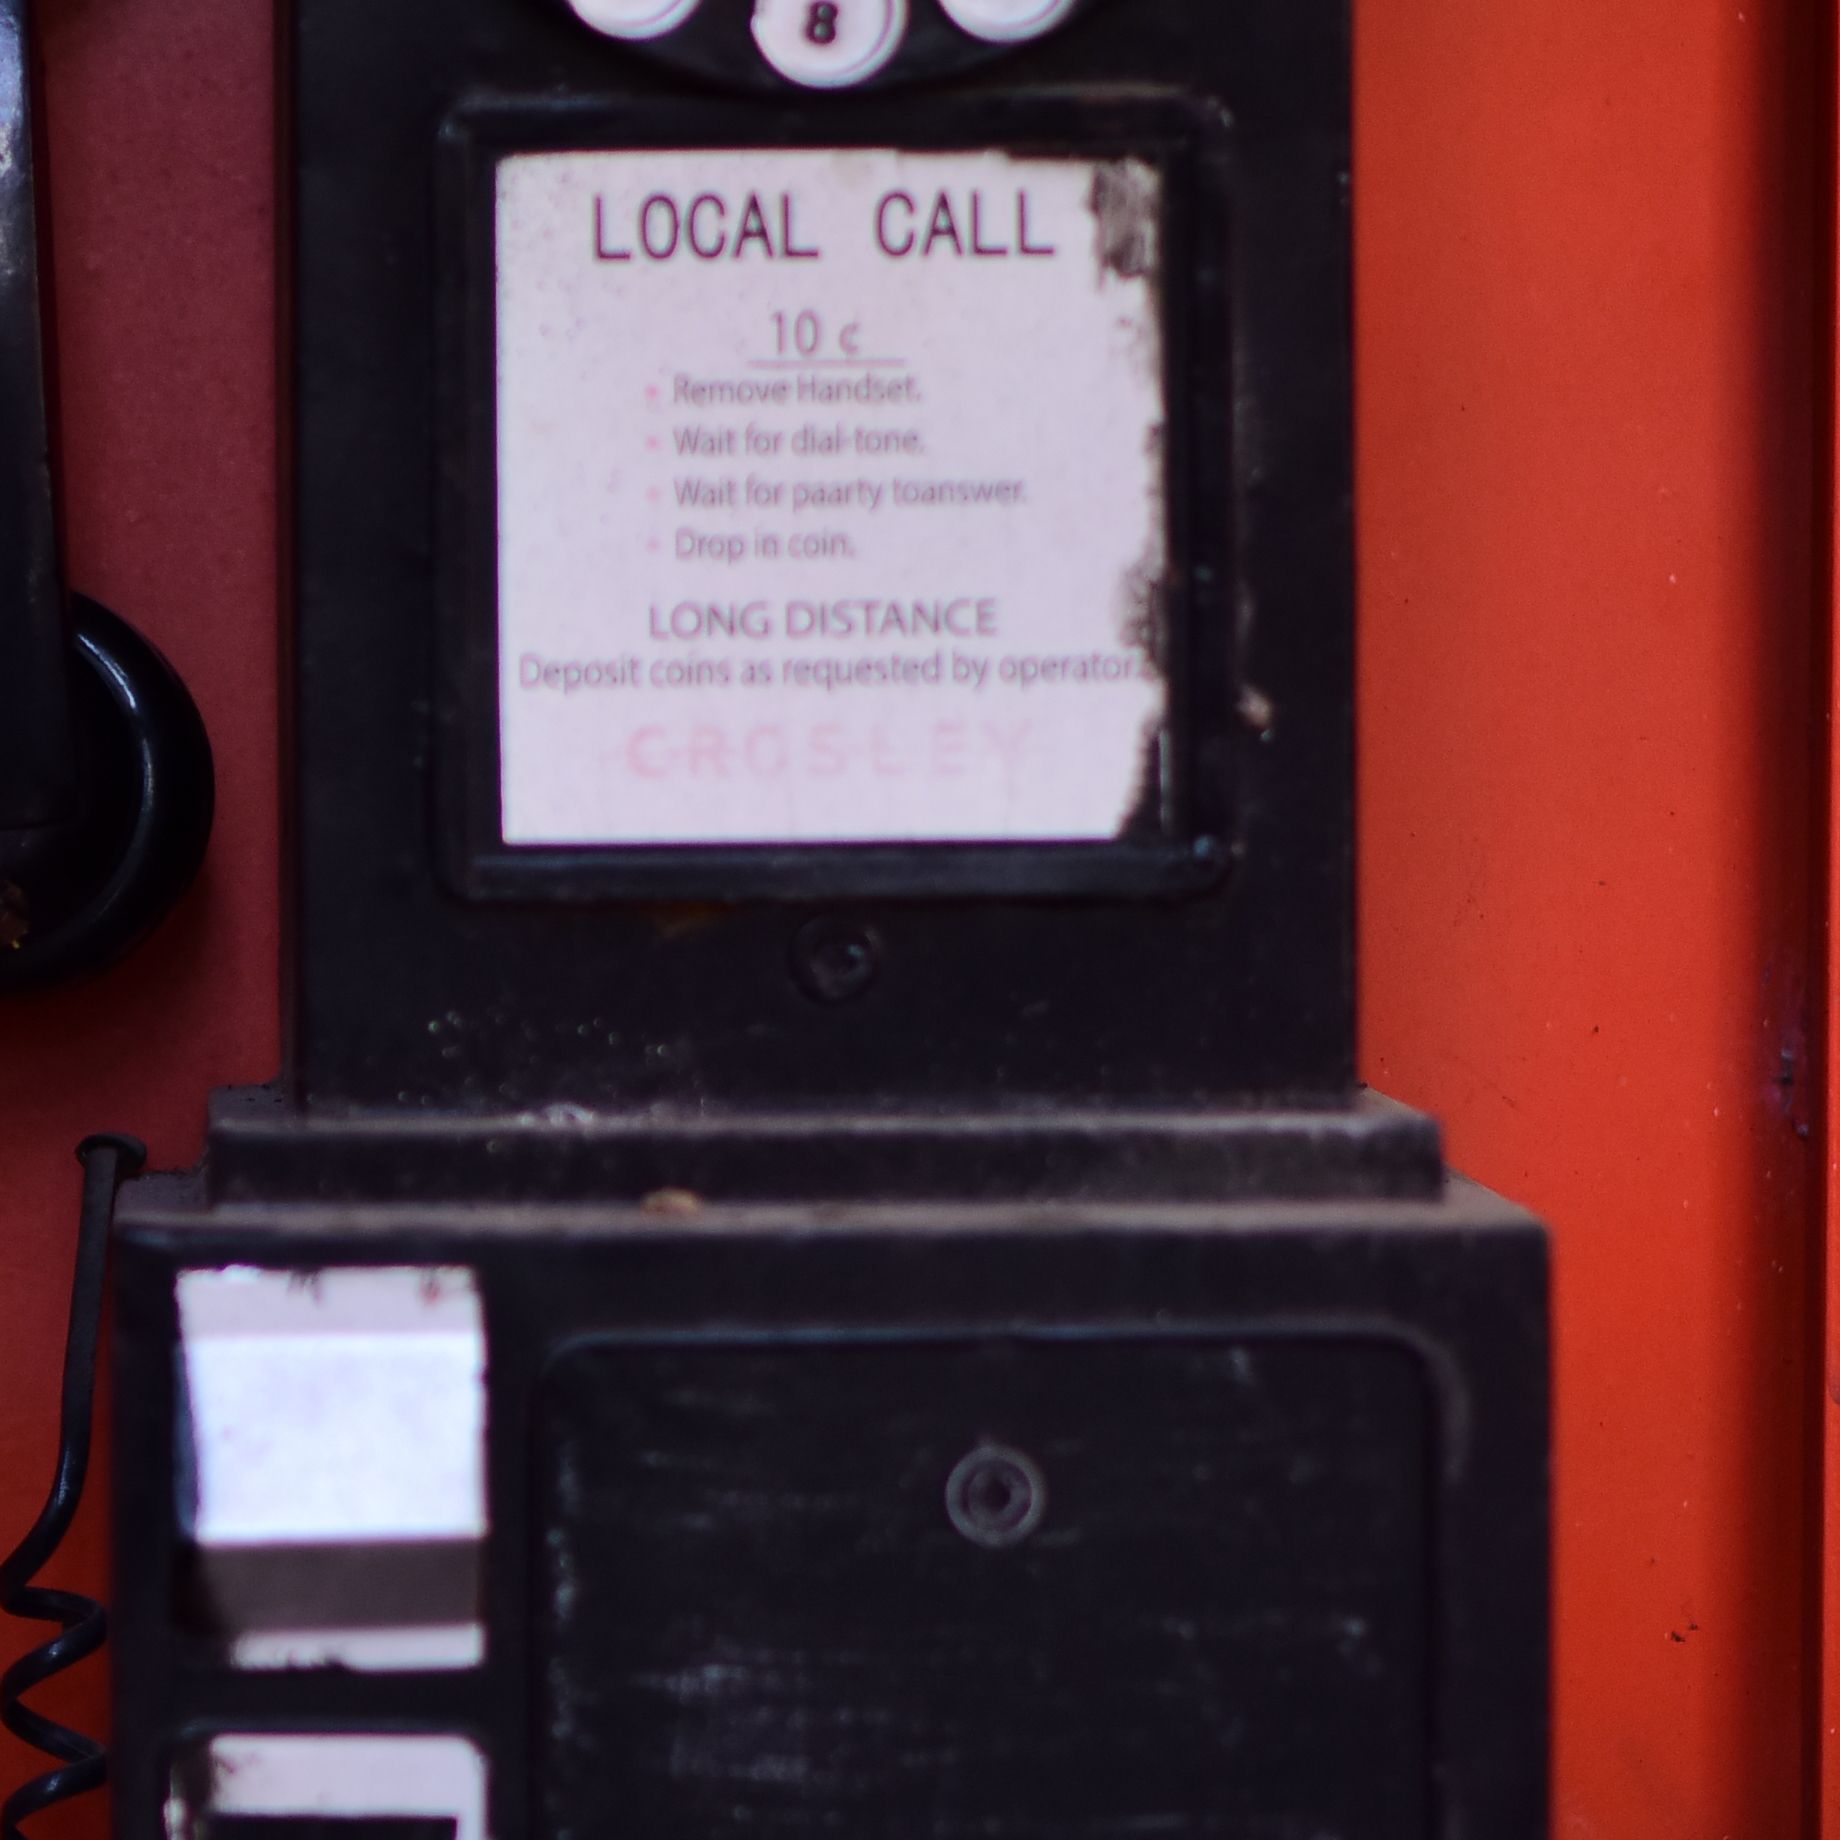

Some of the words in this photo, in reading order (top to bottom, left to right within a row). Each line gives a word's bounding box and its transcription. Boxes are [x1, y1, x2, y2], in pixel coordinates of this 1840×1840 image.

[593, 190, 821, 263] LOCAL
[874, 189, 1056, 259] CALL
[771, 309, 822, 357] 10
[673, 371, 791, 405] Remove
[673, 425, 738, 458] Wait
[744, 422, 784, 456] for
[674, 477, 738, 510] Wait
[745, 473, 784, 507] for
[675, 527, 748, 566] Drop
[754, 532, 782, 558] in
[649, 600, 774, 641] LONG
[785, 597, 998, 640] DISTANCE
[519, 652, 643, 696] Deposit
[650, 650, 734, 689] coins
[740, 658, 776, 688] as
[782, 648, 945, 695] requested
[952, 648, 992, 693] by
[624, 720, 1037, 781] CROSLEY
